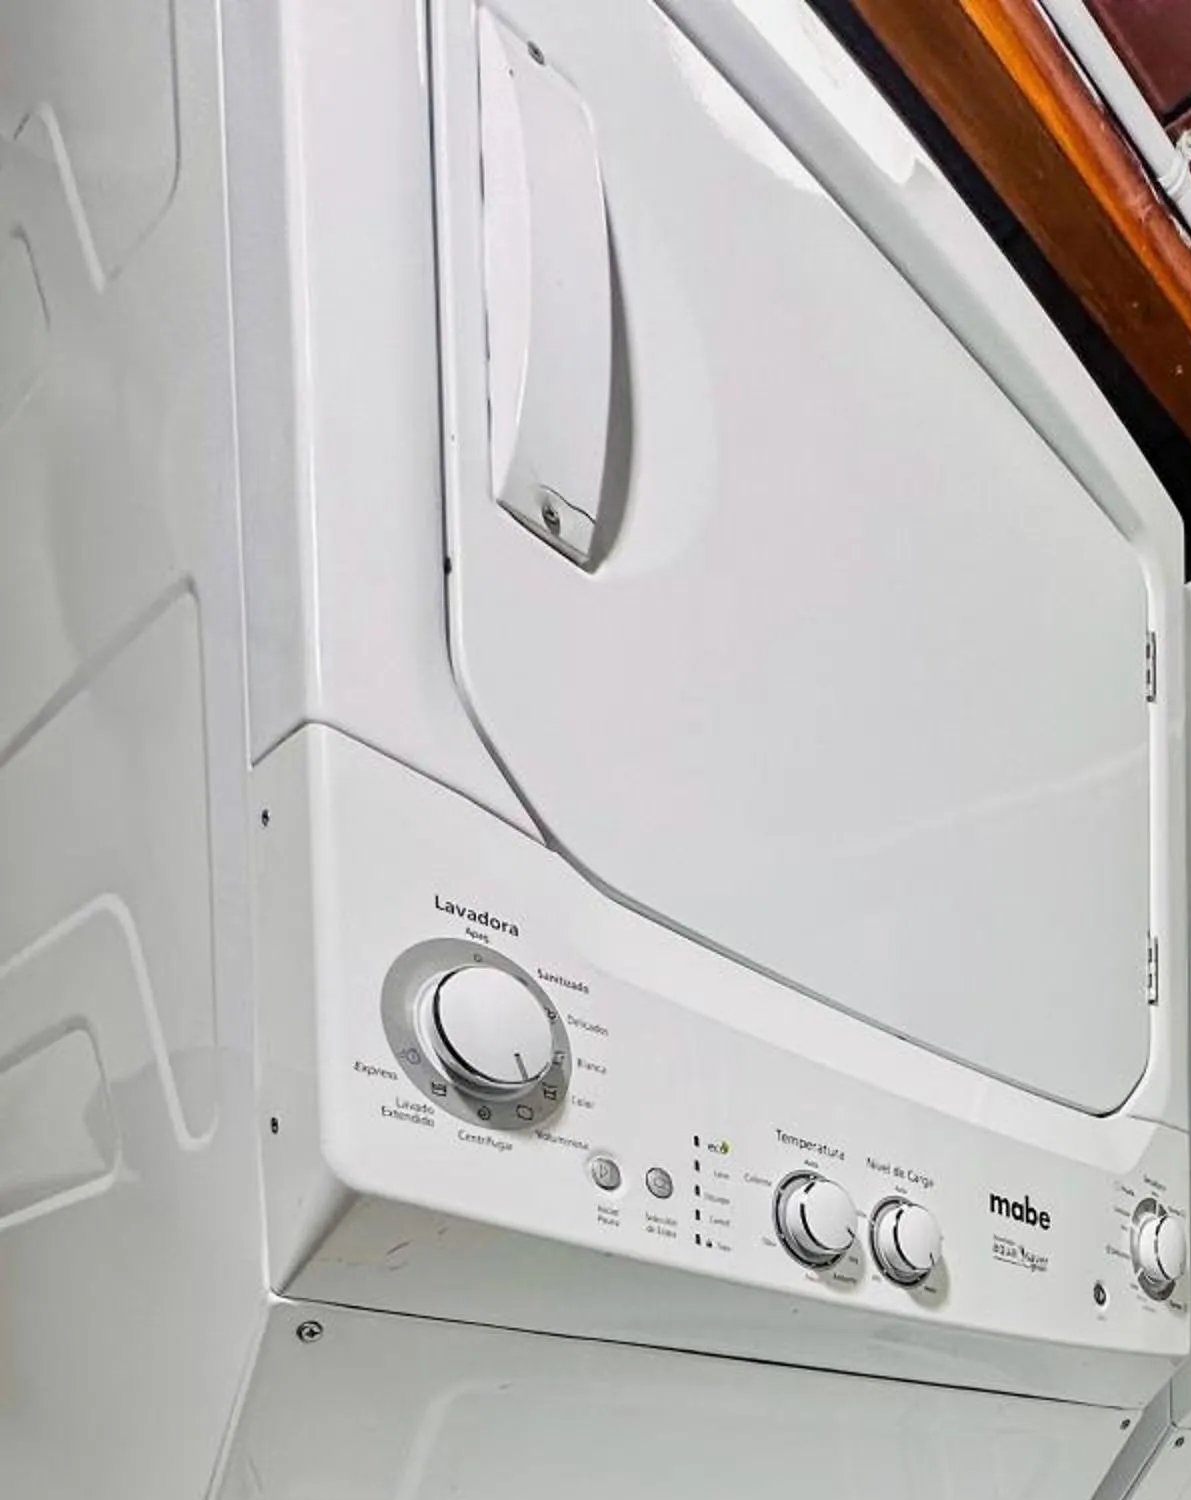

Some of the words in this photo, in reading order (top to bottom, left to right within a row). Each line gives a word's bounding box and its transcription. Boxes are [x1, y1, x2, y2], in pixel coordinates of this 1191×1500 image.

[433, 894, 520, 938] Lavadora
[536, 967, 590, 994] Sanitizado
[353, 1060, 399, 1082] Express
[380, 1104, 435, 1129] Extendido
[774, 1127, 846, 1161] Temperatura
[866, 1156, 892, 1176] Nivel
[892, 1165, 905, 1178] de
[907, 1169, 935, 1189] Carga
[988, 1192, 1052, 1231] mabe
